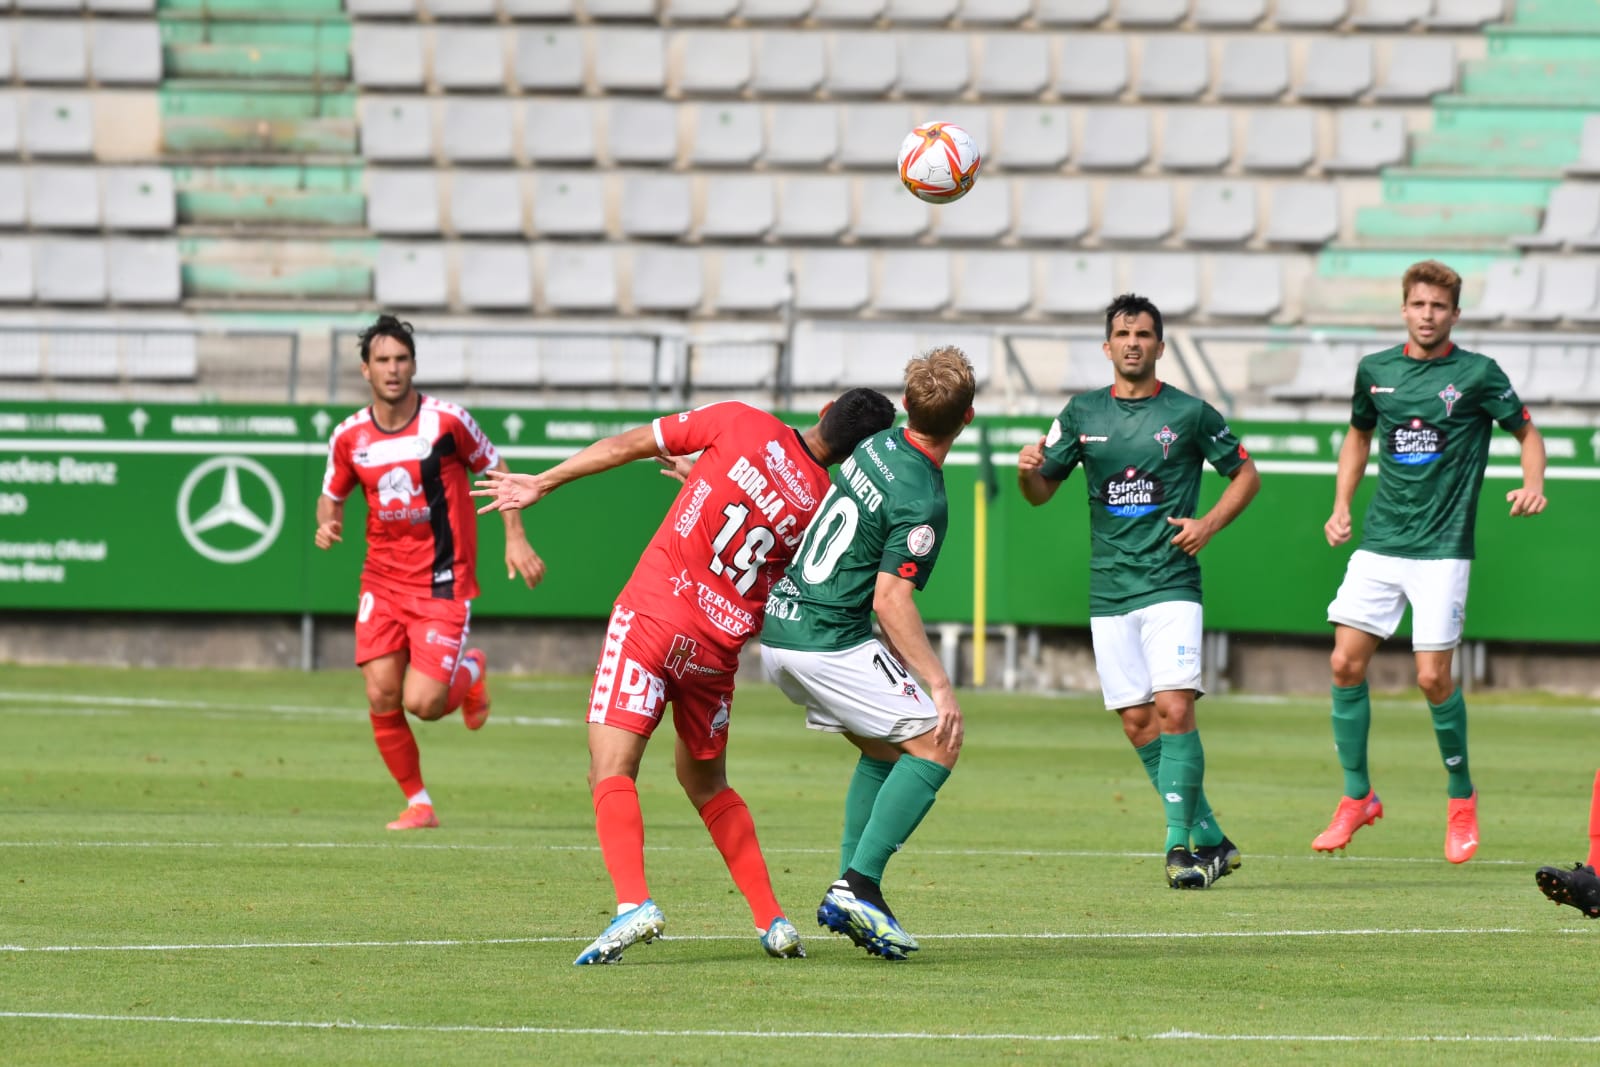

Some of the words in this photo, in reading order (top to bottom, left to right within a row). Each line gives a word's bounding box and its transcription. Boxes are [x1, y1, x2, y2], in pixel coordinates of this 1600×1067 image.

[1394, 428, 1438, 441] Estrella
[1395, 440, 1437, 453] Galicia
[727, 456, 785, 523] BORJA
[849, 467, 883, 513] NIETO
[1107, 480, 1153, 495] Estrella
[1108, 491, 1151, 505] Galicia
[708, 501, 776, 597] 19
